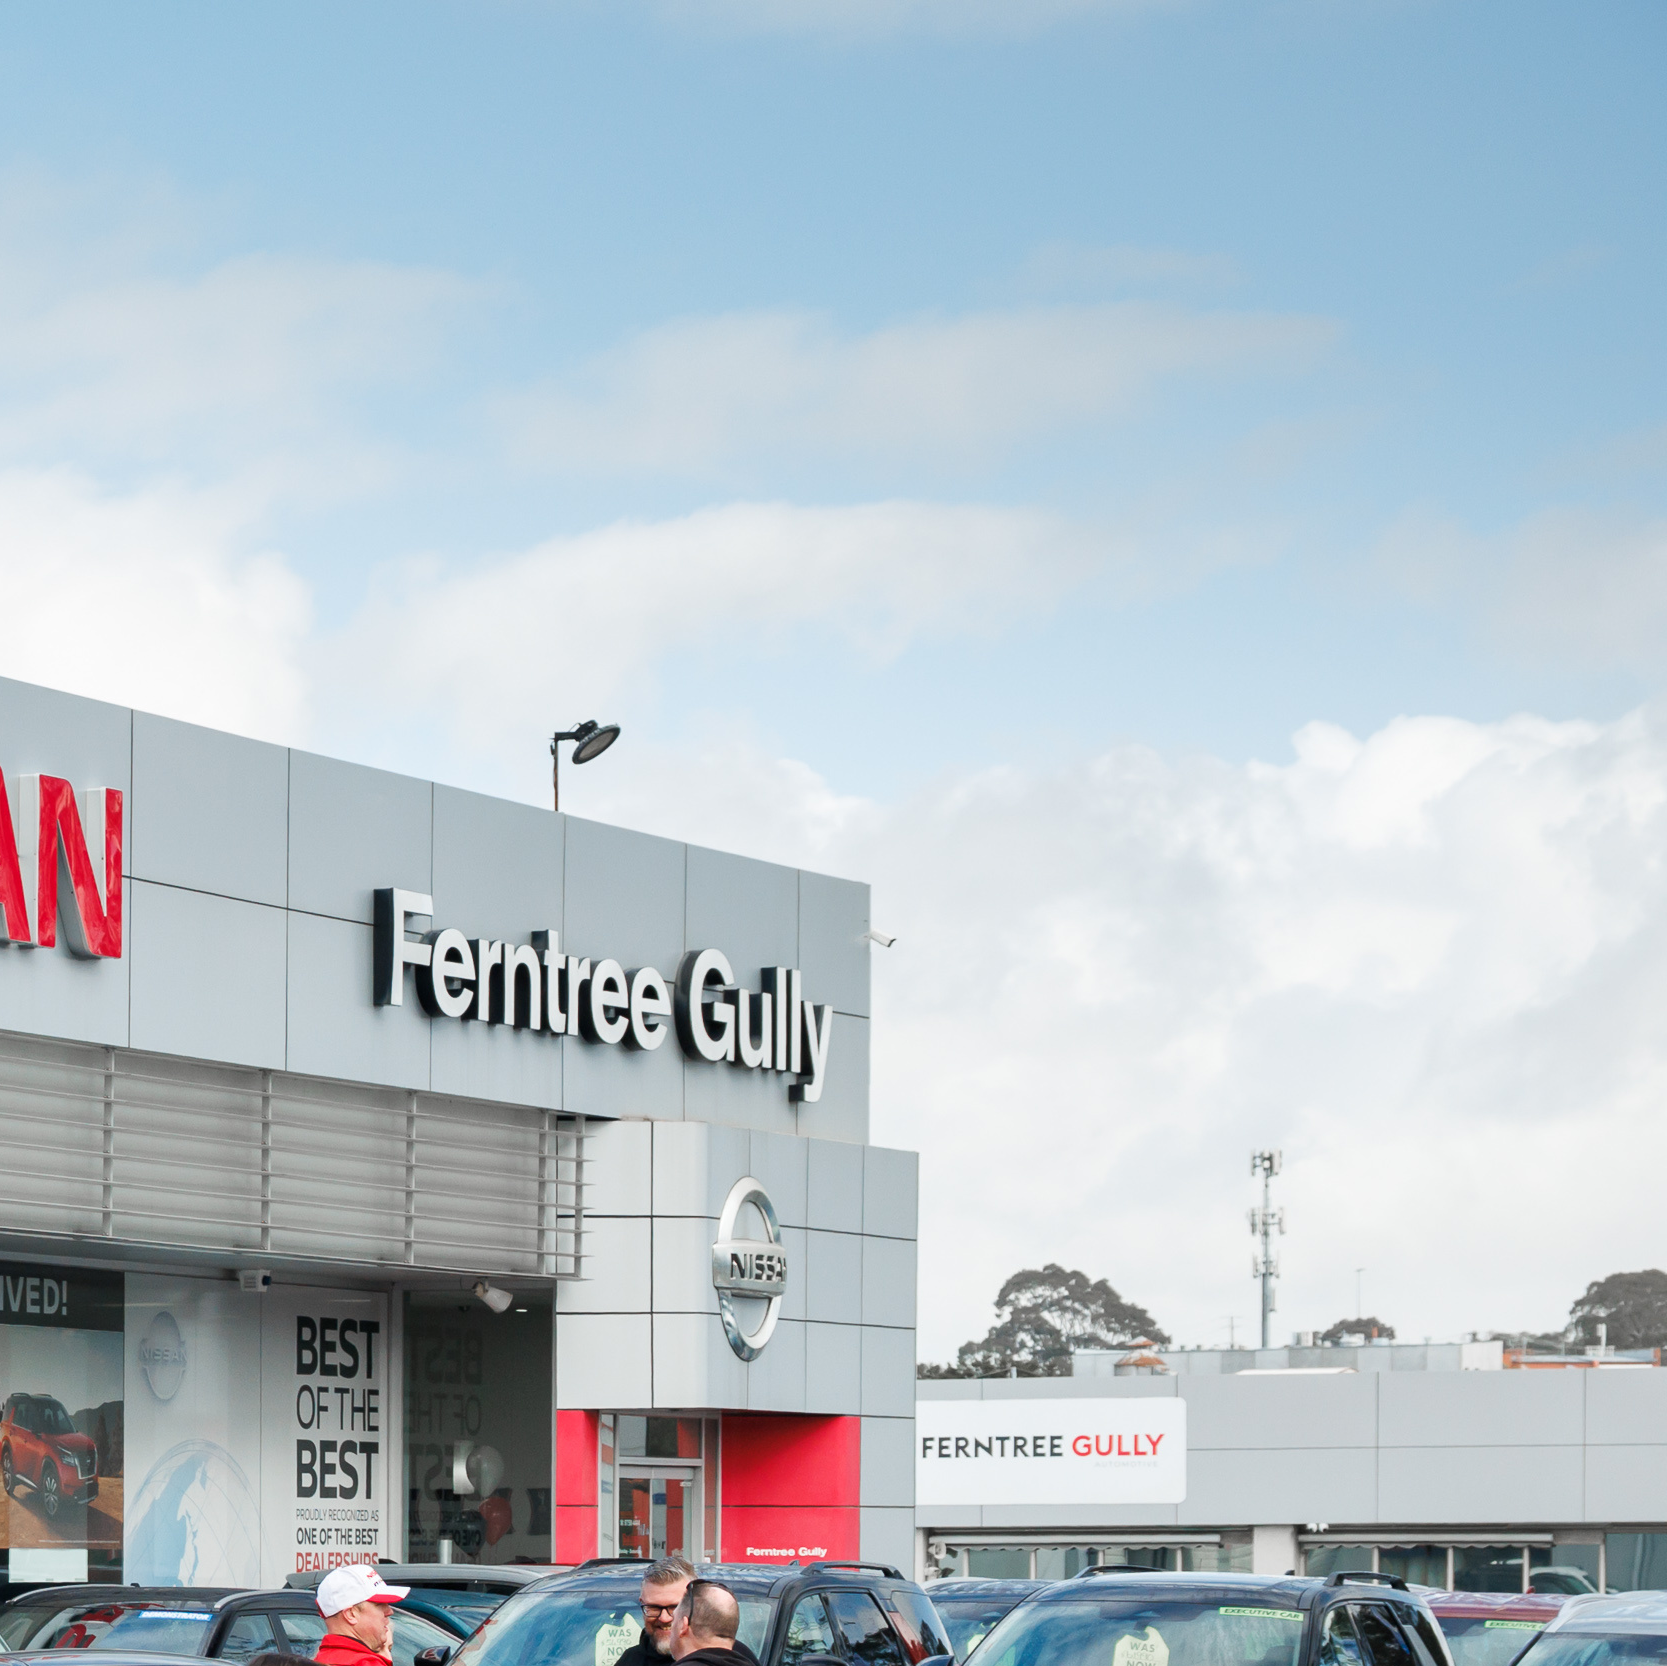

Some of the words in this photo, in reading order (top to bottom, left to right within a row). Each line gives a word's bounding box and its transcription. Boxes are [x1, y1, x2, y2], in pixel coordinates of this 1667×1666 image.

[373, 887, 670, 1053] Ferntree
[674, 947, 833, 1103] Gully
[296, 1315, 380, 1379] BEST
[296, 1384, 329, 1430] OF
[334, 1387, 380, 1432] THE
[922, 1436, 1064, 1458] FERNTREE
[1072, 1434, 1165, 1457] GULLY
[296, 1439, 379, 1500] BEST
[296, 1508, 327, 1521] PROUDLY
[328, 1509, 369, 1522] RECOGNIZED
[370, 1510, 379, 1522] AS
[296, 1527, 317, 1545] ONE
[319, 1528, 333, 1545] OF
[334, 1528, 353, 1545] THE
[355, 1528, 379, 1546] BEST
[746, 1547, 795, 1557] Ferntree
[798, 1546, 828, 1558] Gully
[141, 1611, 210, 1620] DEMONSTRATOR
[1224, 1607, 1278, 1617] EXECUTIVE
[1279, 1611, 1301, 1619] CAR
[1489, 1621, 1538, 1630] EXECUTIVE
[608, 1628, 632, 1638] WAS
[607, 1647, 627, 1656] NO
[1130, 1642, 1155, 1652] WAS
